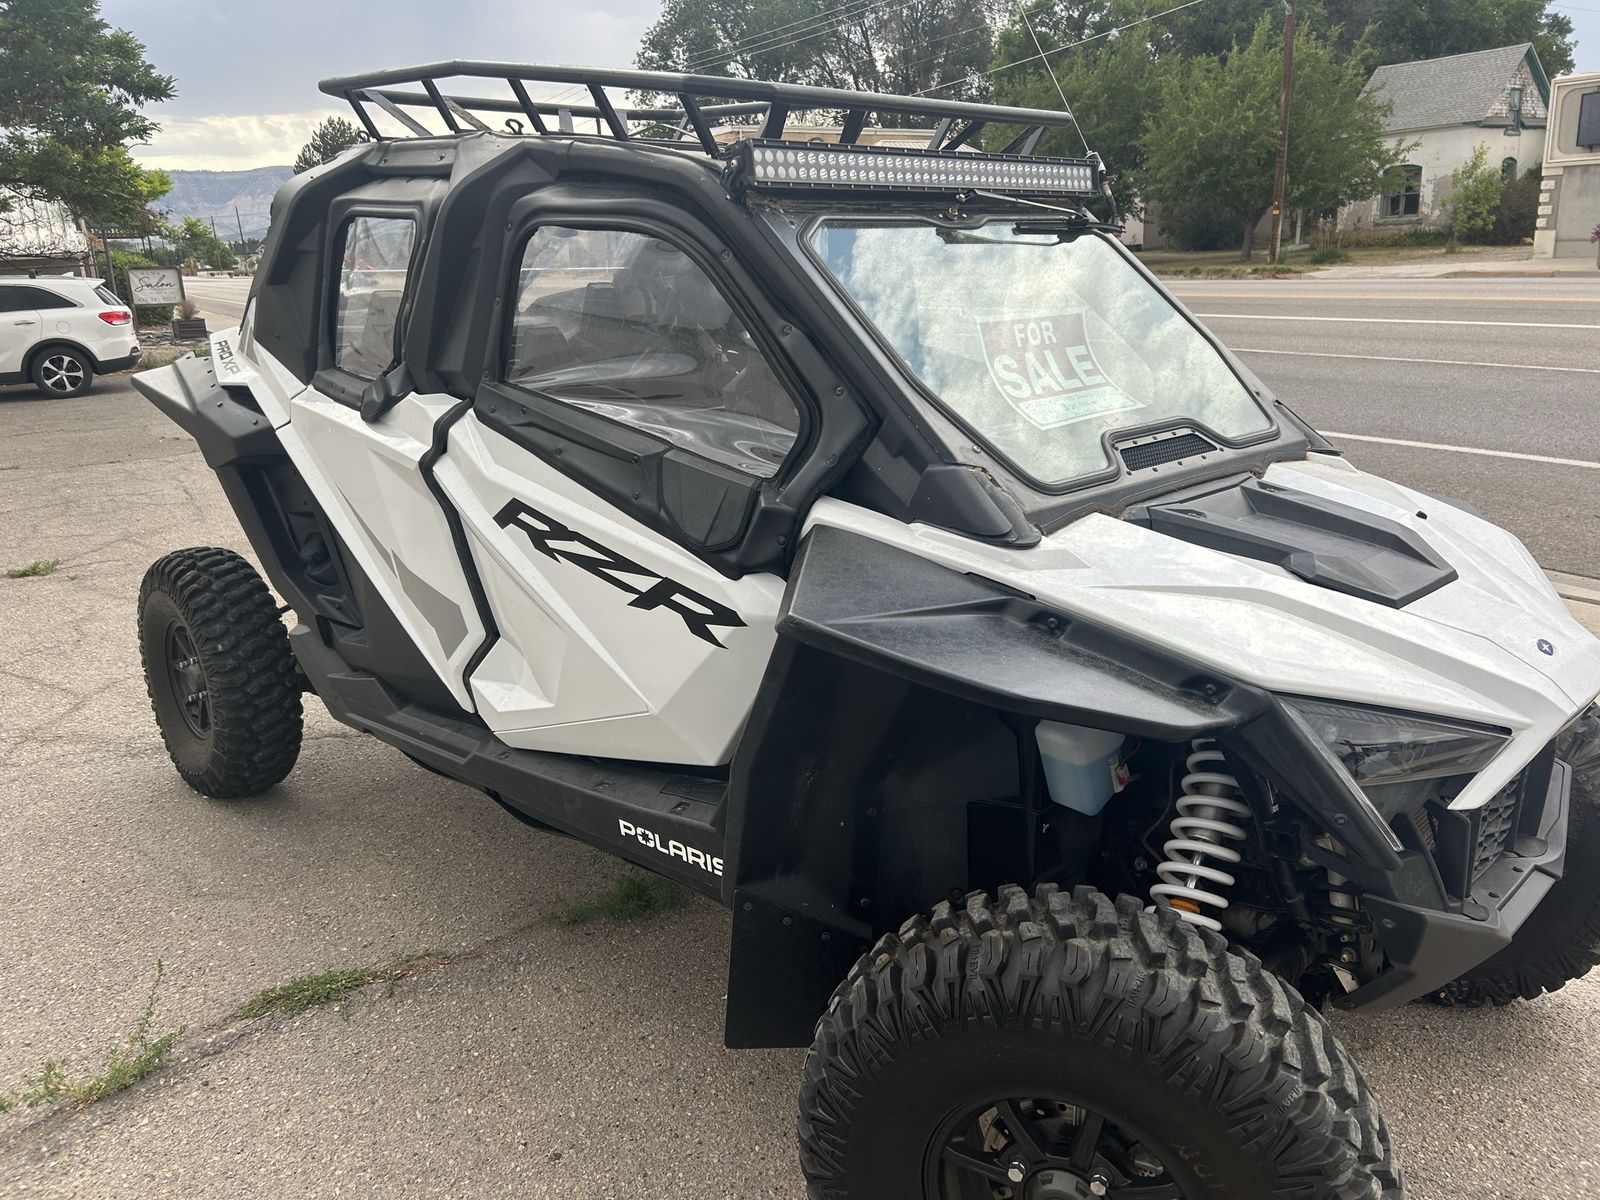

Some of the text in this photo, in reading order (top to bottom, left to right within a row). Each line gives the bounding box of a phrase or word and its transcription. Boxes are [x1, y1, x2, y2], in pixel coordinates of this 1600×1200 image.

[135, 274, 176, 292] Salon
[1013, 321, 1057, 348] FOR
[993, 345, 1106, 399] SALE
[493, 497, 749, 650] RZR
[618, 818, 724, 877] POLARIS
